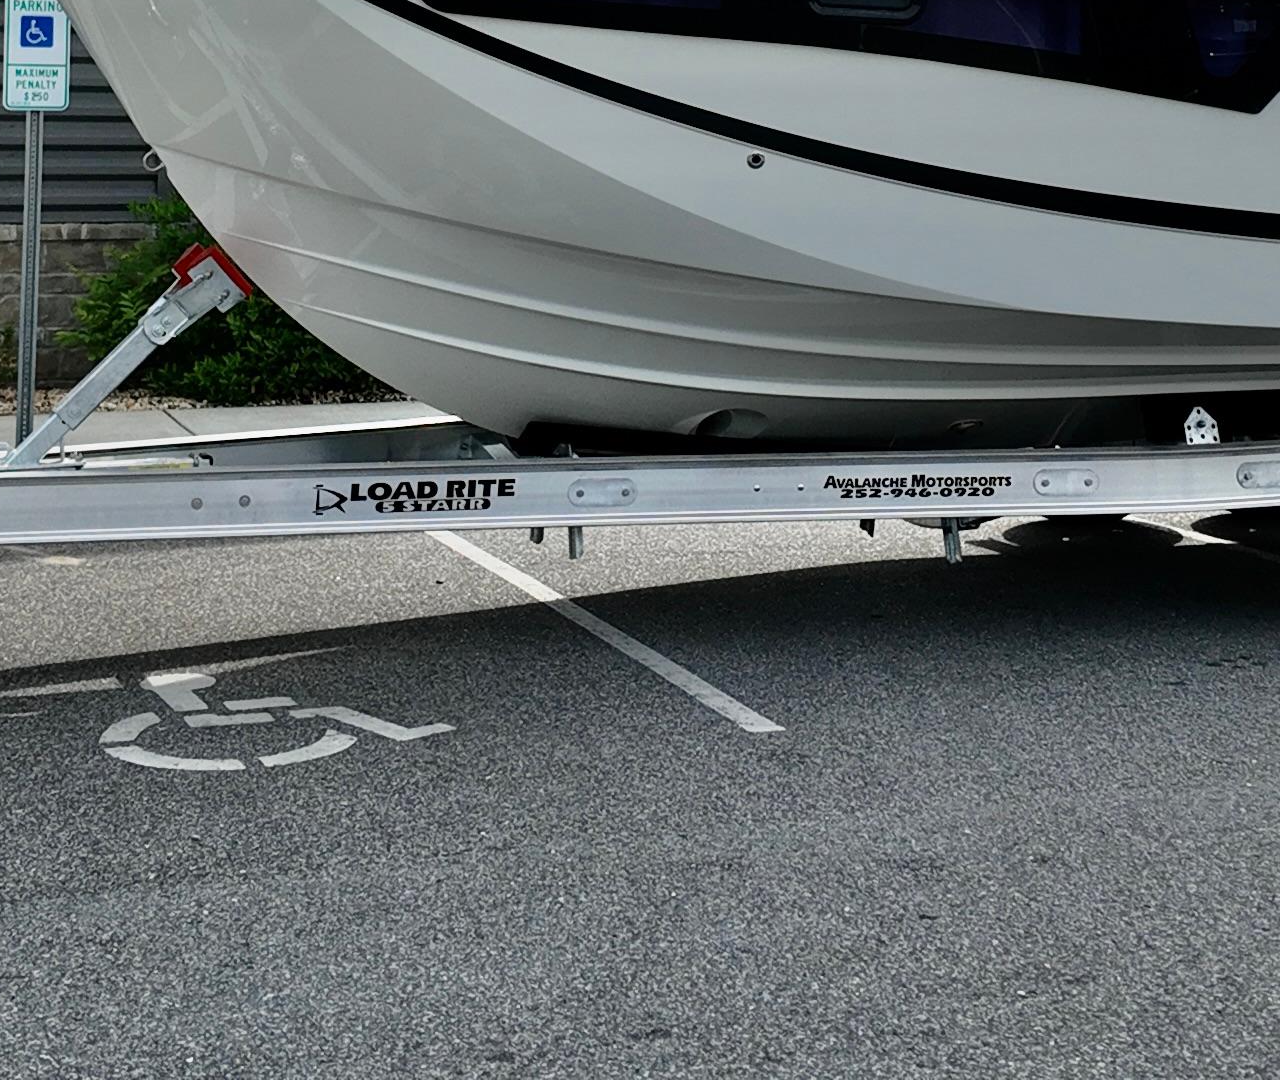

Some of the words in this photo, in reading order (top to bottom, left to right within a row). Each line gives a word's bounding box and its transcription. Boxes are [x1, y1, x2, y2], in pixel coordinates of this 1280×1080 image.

[15, 69, 59, 78] MAXIMUM
[16, 80, 56, 90] PENALTY
[823, 475, 907, 489] AVALANCHE
[911, 474, 1012, 488] MOTORSPORTS
[350, 481, 439, 502] LOAD
[445, 478, 516, 499] RITE
[840, 487, 996, 499] 252-946-0920
[382, 500, 395, 513] 5
[402, 498, 485, 512] STARR
